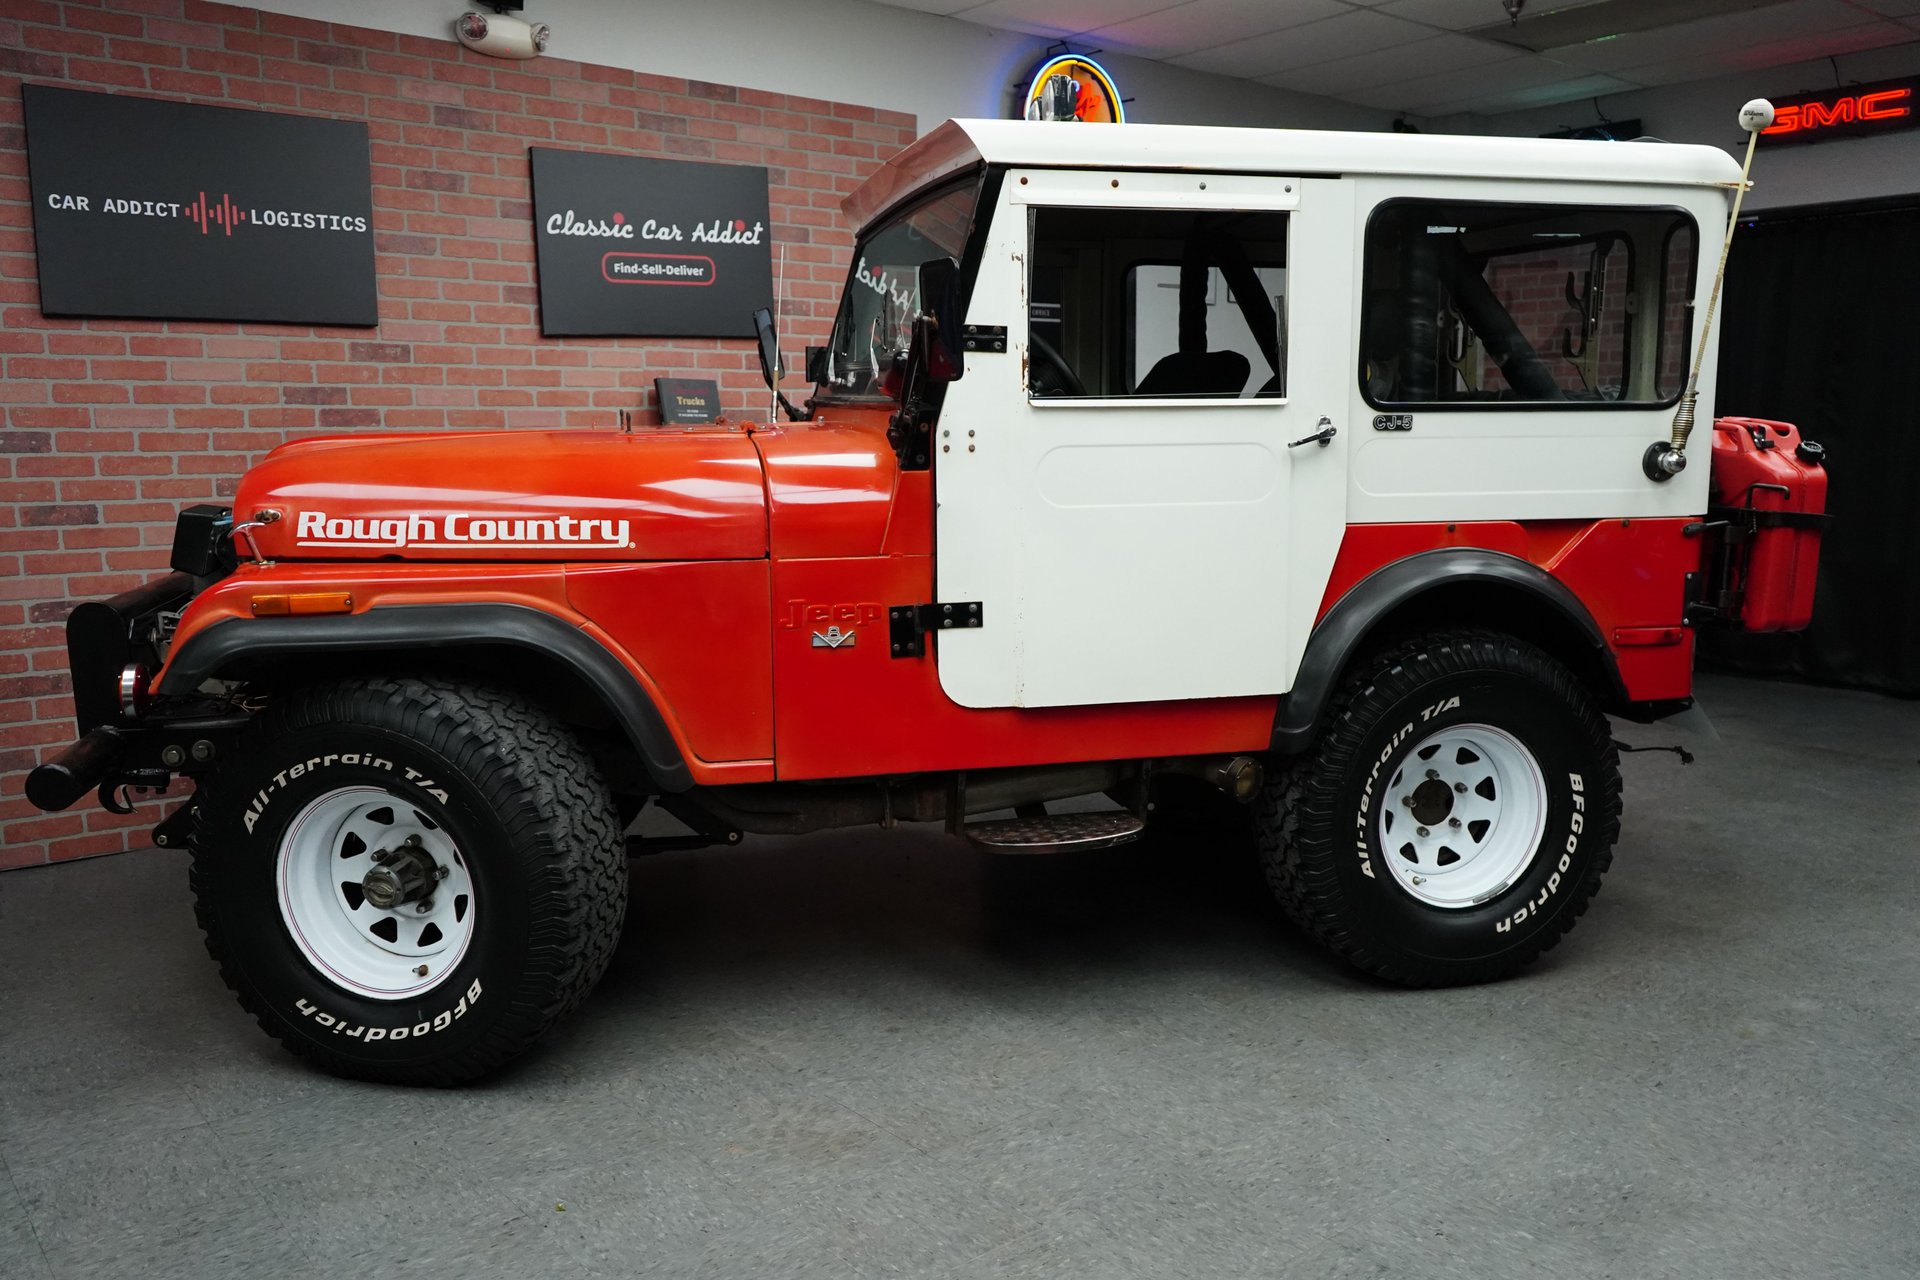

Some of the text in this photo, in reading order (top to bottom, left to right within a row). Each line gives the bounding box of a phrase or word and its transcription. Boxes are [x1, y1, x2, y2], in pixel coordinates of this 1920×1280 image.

[1760, 88, 1911, 135] GMC
[48, 192, 366, 232] CAR ADDICT LOGISTICS
[546, 209, 763, 245] Classic Car Addict
[614, 262, 705, 277] Find-Sell-Deliver
[676, 396, 705, 406] Trucks
[1374, 415, 1413, 430] CJ-5
[297, 511, 436, 548] Rough
[779, 599, 883, 631] Jeep
[242, 752, 450, 836] All-Terrain T/A
[1352, 695, 1461, 880] All-Terrain T/A
[1495, 772, 1586, 934] BFGoodrich
[296, 977, 484, 1043] BFGoodrich
